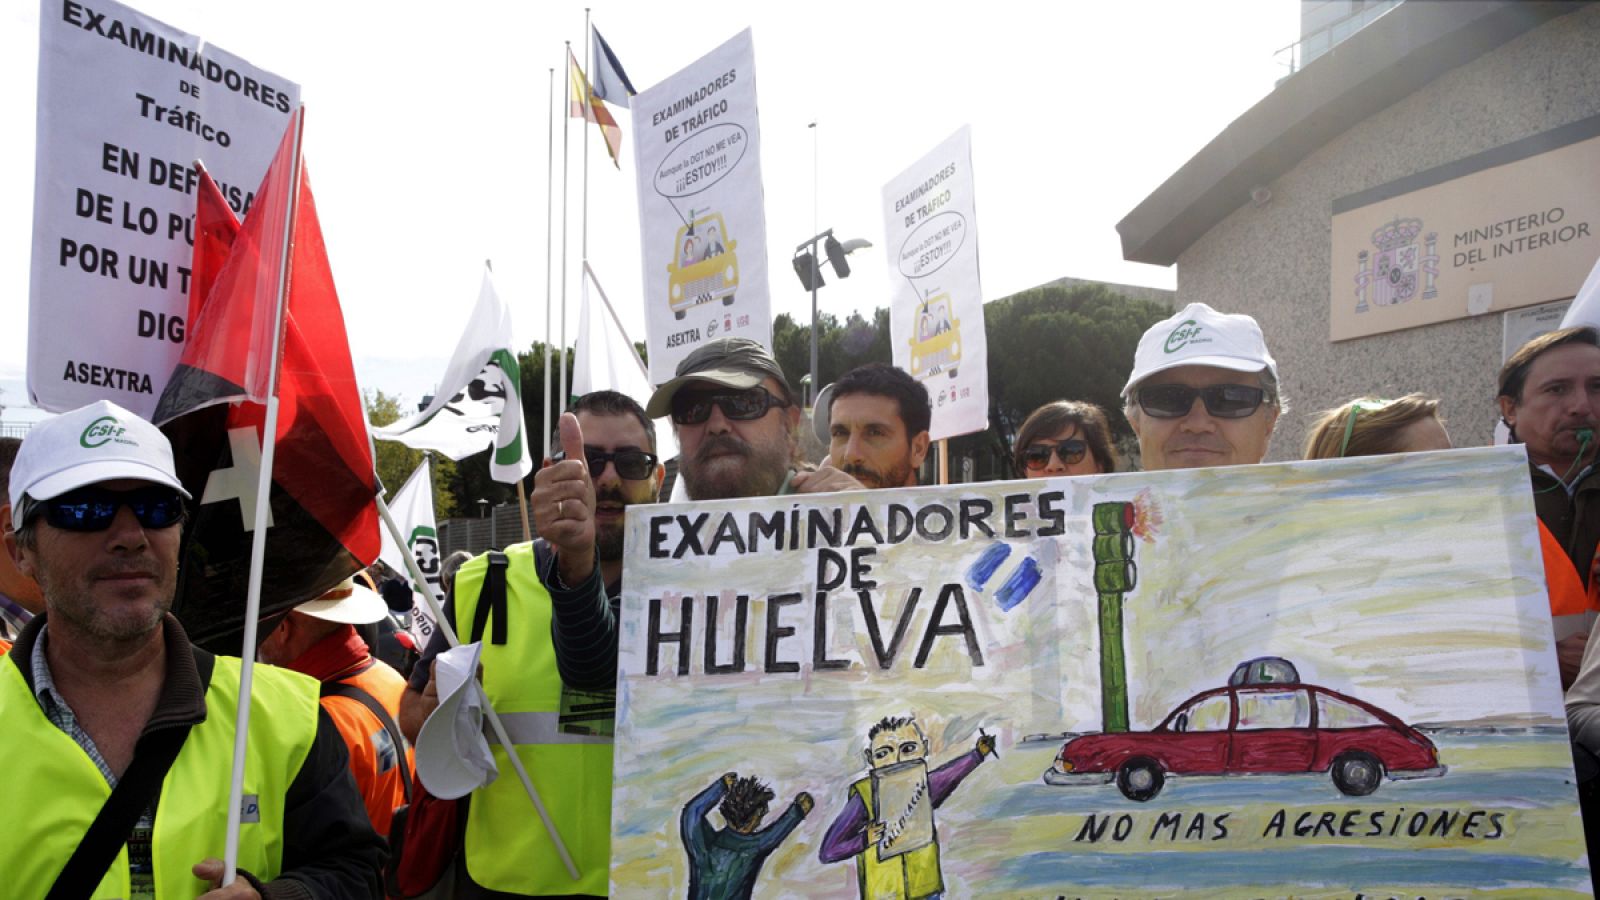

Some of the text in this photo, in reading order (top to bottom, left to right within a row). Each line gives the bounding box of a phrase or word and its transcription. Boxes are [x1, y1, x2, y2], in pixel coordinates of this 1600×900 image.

[62, 0, 291, 114] EXAMINADORES
[179, 79, 201, 100] DE
[652, 68, 736, 127] EXAMINADORES
[135, 92, 232, 149] Tráfico
[664, 124, 680, 143] DE
[102, 142, 140, 181] EN
[690, 150, 704, 165] DGT
[704, 144, 716, 157] NO
[726, 131, 742, 146] VEA
[895, 161, 956, 214] EXAMINADORES
[75, 186, 114, 225] DE
[122, 200, 158, 236] LO
[904, 211, 916, 229] DE
[1453, 206, 1565, 248] MINISTERIO
[60, 237, 120, 280] POR
[128, 254, 169, 290] UN
[1453, 221, 1591, 268] DEL INTERIOR
[137, 310, 185, 344] DIG
[666, 327, 702, 350] ASEXTRA
[62, 360, 154, 395] ASEXTRA
[816, 546, 878, 592] DE
[645, 582, 985, 676] HUELVA
[1073, 813, 1133, 844] NO
[1149, 811, 1232, 841] MAS
